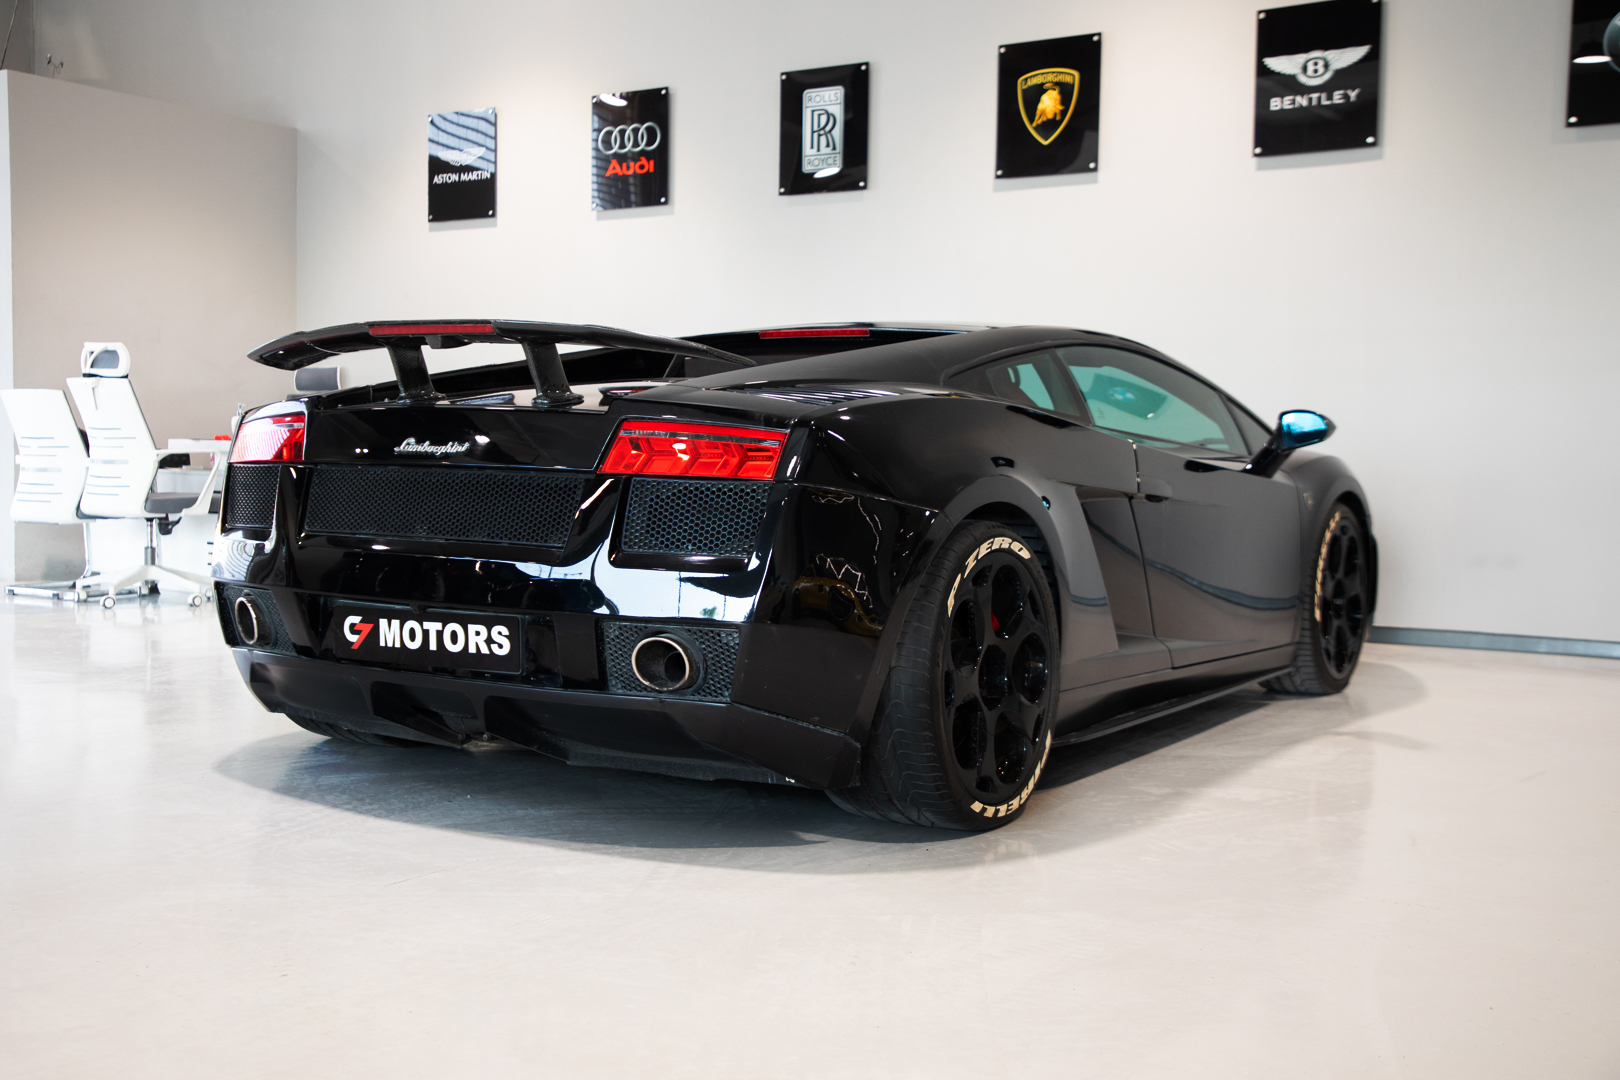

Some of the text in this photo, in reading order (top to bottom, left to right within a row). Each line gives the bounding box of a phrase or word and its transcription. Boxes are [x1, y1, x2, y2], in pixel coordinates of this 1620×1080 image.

[1306, 58, 1326, 76] B
[1021, 72, 1075, 89] LAMBORGHINI
[806, 91, 840, 105] ROLLS
[1269, 87, 1362, 111] BENTLEY
[604, 155, 655, 177] Audi
[806, 155, 839, 168] ROYCE
[432, 169, 491, 185] ASTON MARTIN
[393, 436, 471, 456] Lamborghini
[946, 536, 1032, 618] P ZERO
[378, 618, 512, 656] MOTORS
